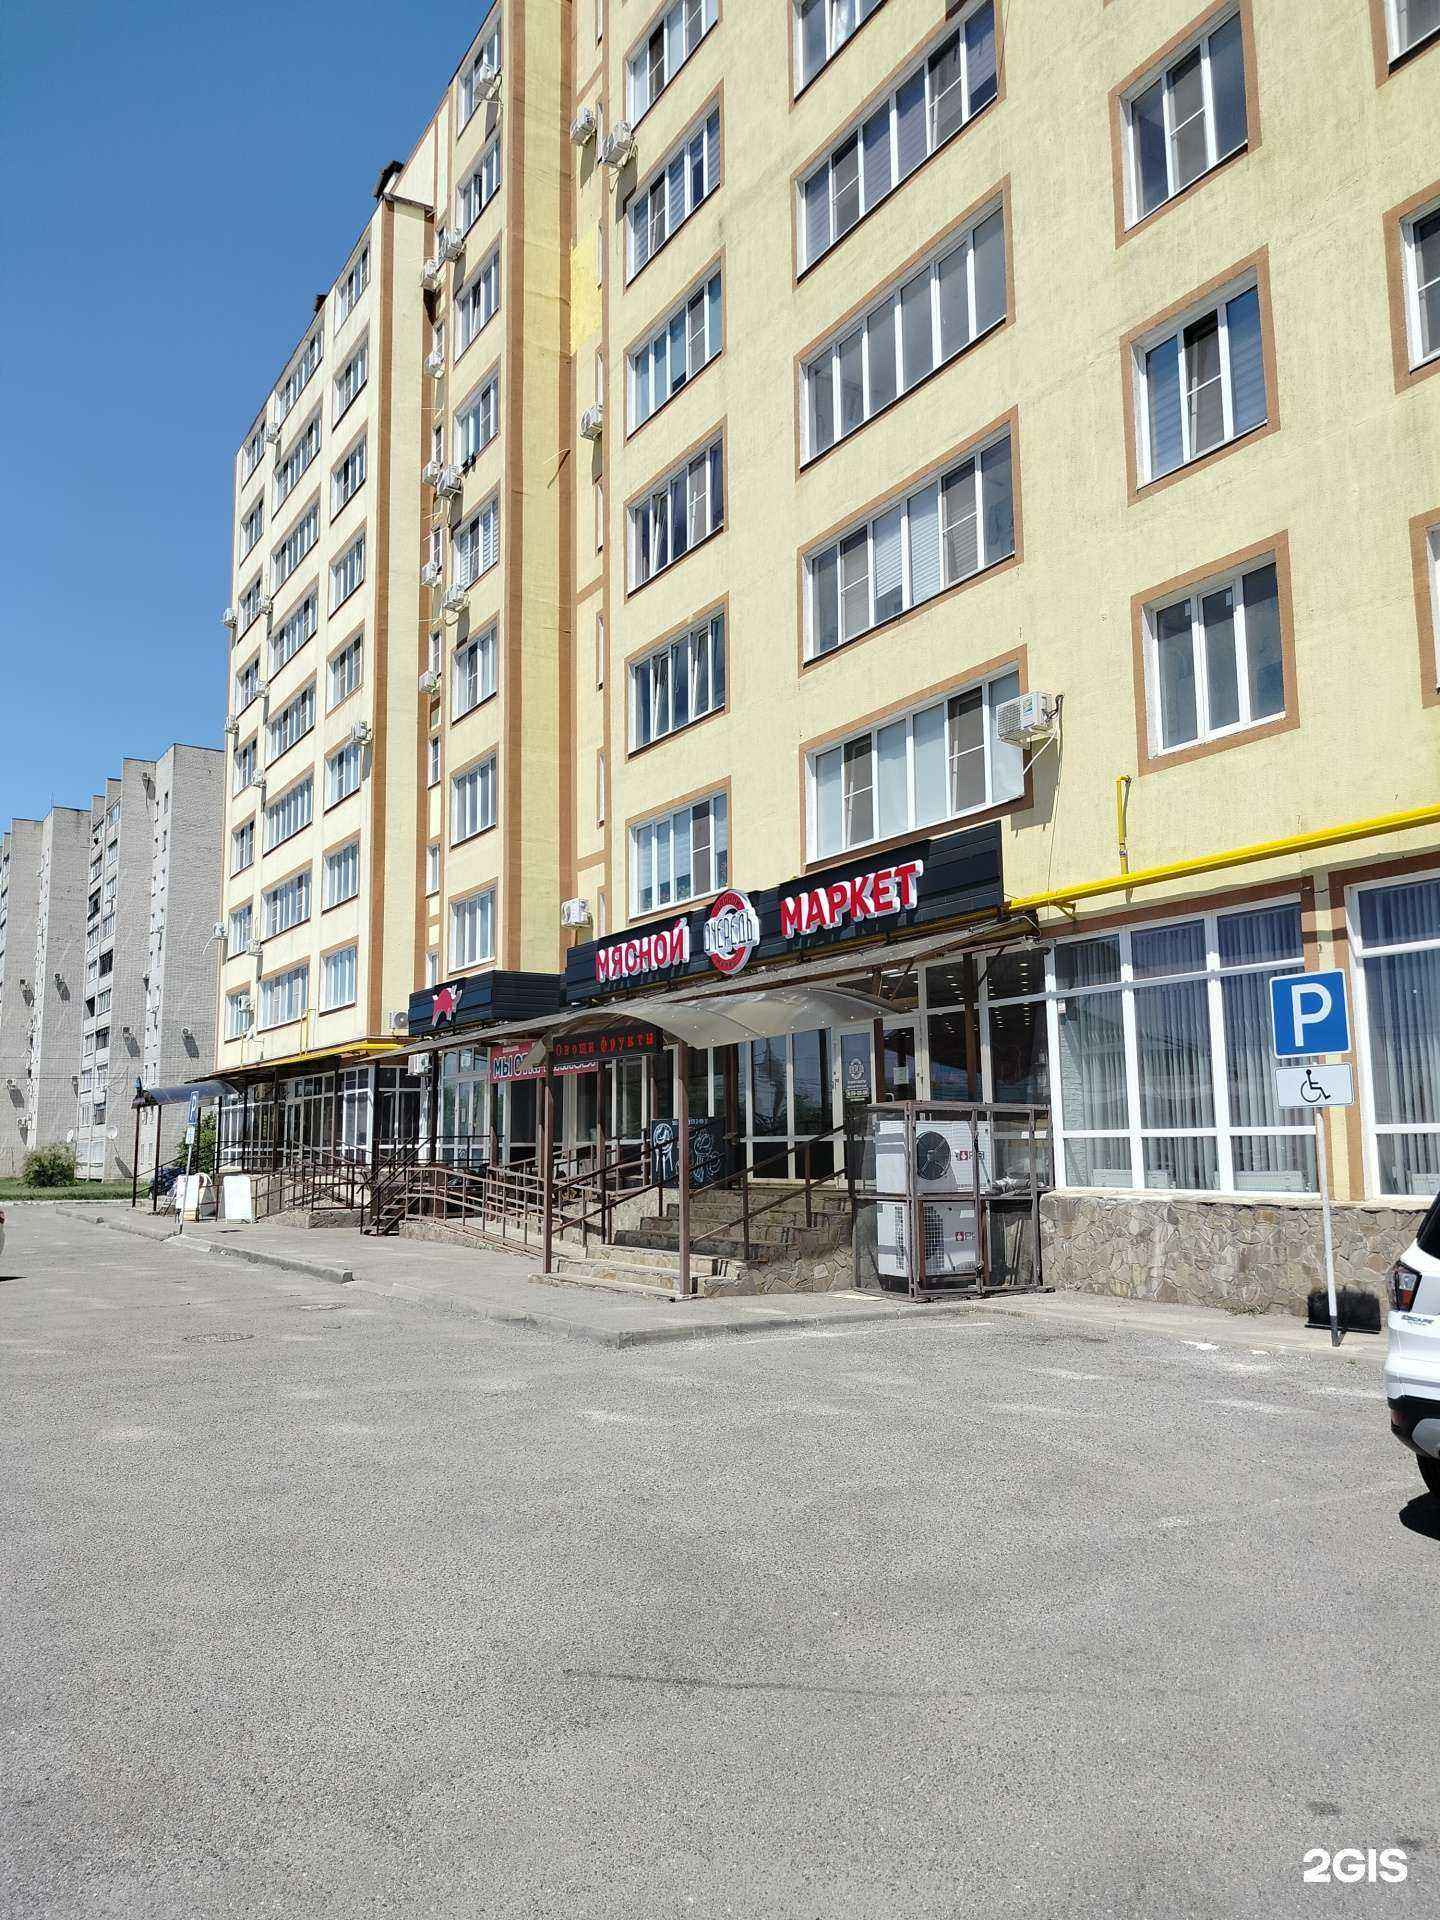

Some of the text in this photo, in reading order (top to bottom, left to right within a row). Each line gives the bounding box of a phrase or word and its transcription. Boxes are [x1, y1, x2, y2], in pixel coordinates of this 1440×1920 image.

[594, 859, 924, 983] МЯСНОЙ МАРКЕТ
[1290, 984, 1333, 1048] P
[493, 1053, 513, 1079] МЫ
